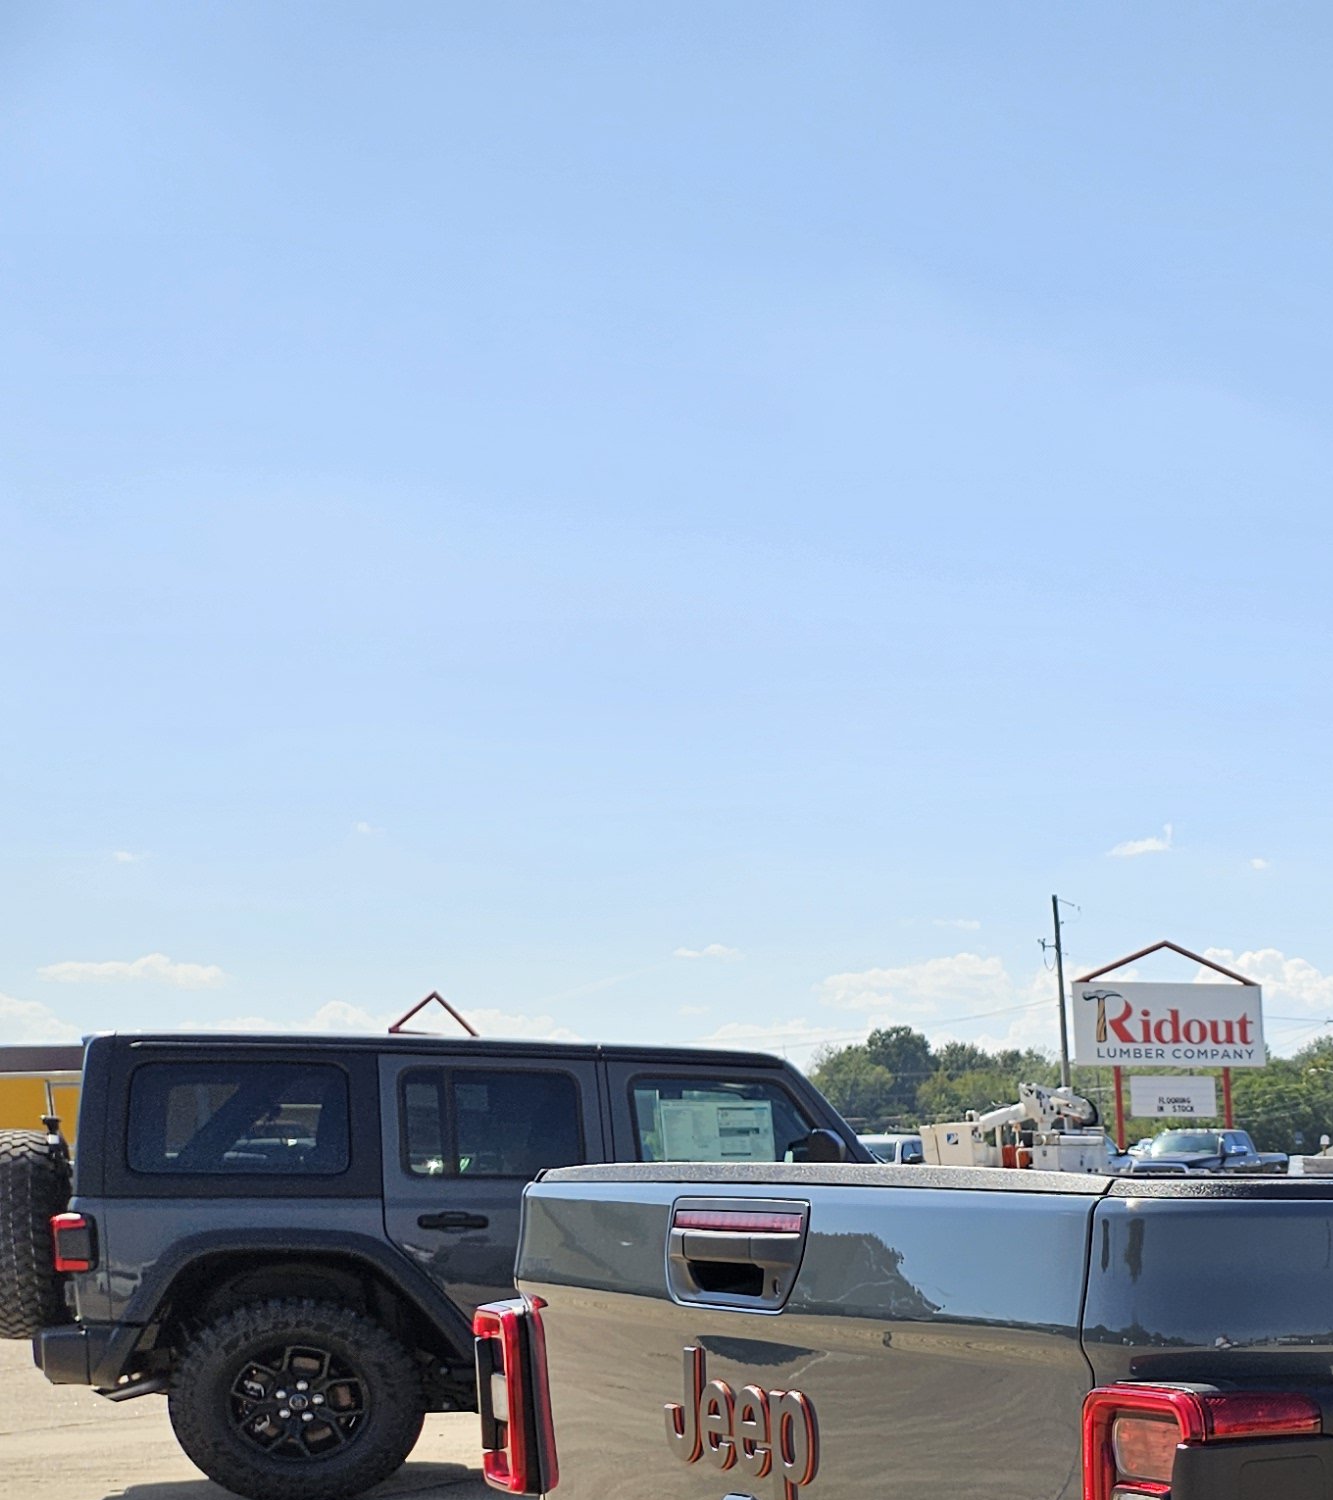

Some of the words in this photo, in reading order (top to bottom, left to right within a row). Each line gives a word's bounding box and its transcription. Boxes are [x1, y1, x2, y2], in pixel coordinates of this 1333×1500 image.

[1083, 989, 1254, 1046] Ridout
[1097, 1047, 1165, 1059] LUMBER
[1171, 1048, 1254, 1060] COMPANY
